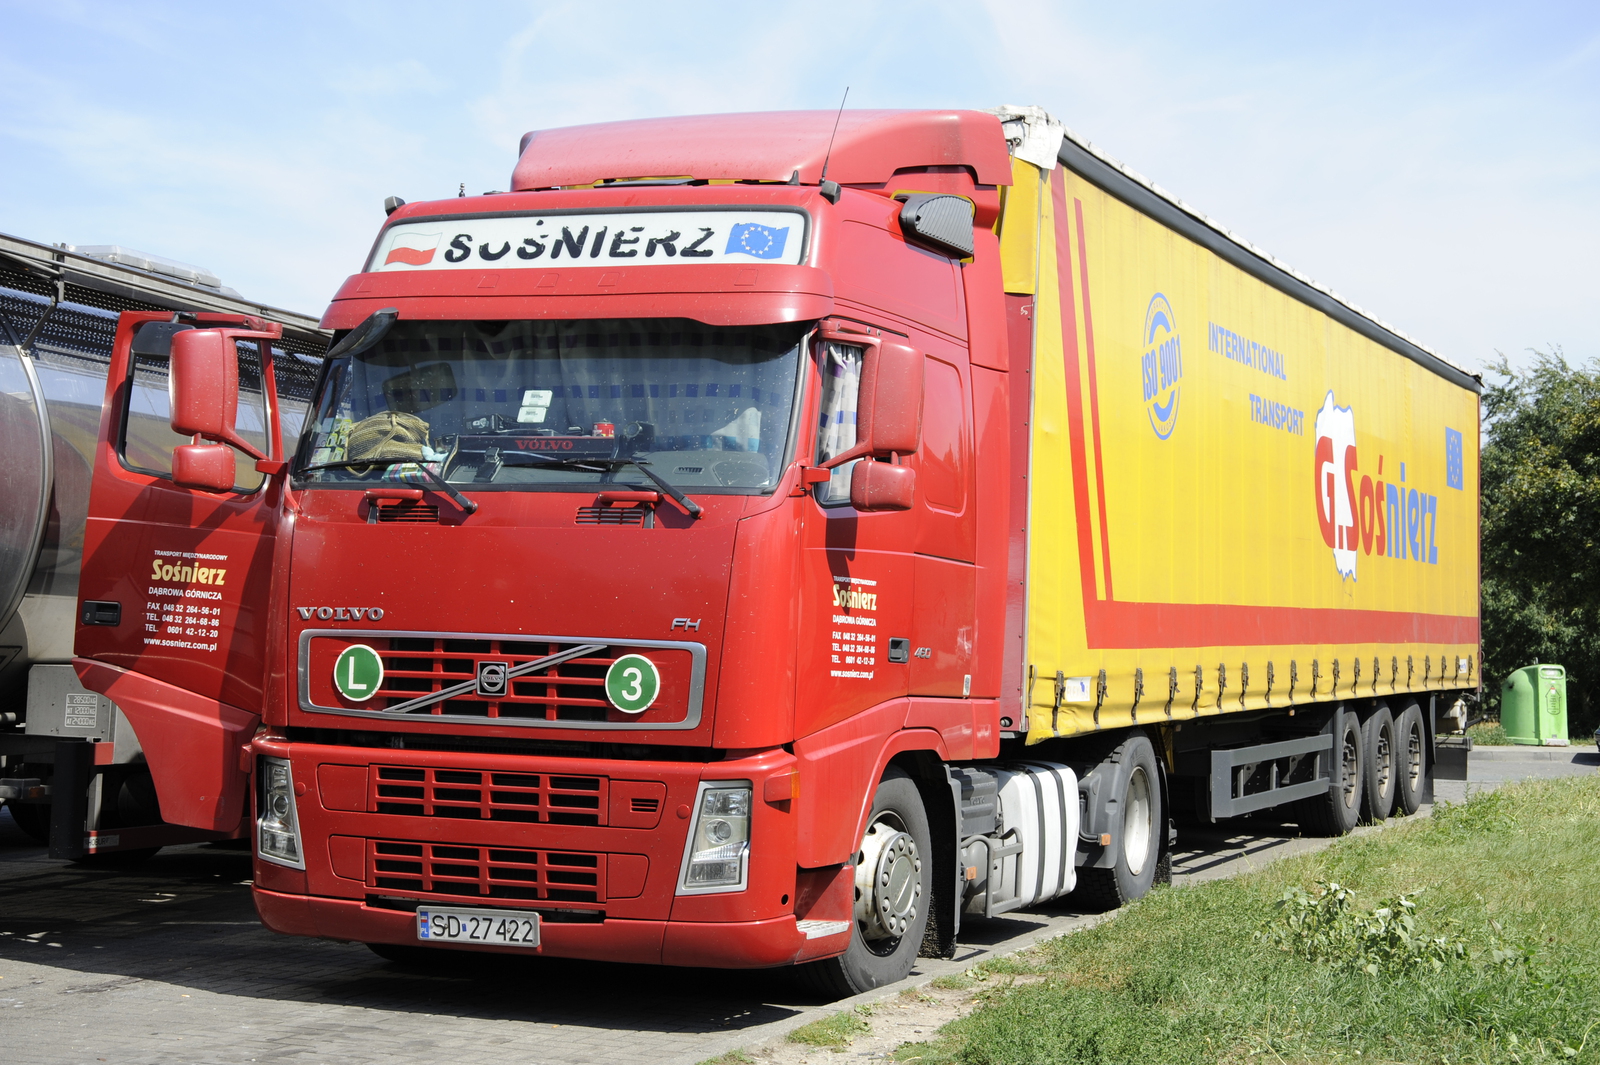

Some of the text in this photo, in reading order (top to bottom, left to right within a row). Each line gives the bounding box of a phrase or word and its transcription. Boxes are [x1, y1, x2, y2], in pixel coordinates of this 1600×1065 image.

[1208, 320, 1287, 381] INTERNATIONAL
[1141, 334, 1183, 402] ISO 9001
[1249, 392, 1304, 437] TRANSPORT
[515, 439, 574, 450] VOLVO
[154, 549, 182, 557] TRANSPORT
[151, 558, 227, 586] Sośnierz
[148, 586, 222, 600] DĄBROWA GÓRNICZA
[832, 583, 877, 611] Sośnierz
[146, 601, 160, 610] FAX
[163, 603, 174, 612] 048
[176, 604, 184, 612] 32
[297, 606, 384, 620] VOLVO
[146, 612, 160, 621] TEL.
[162, 614, 174, 622] 048
[174, 616, 182, 624] 32
[670, 617, 702, 632] FH
[145, 624, 159, 632] TEL.
[167, 626, 182, 634] 0601
[143, 638, 218, 652] www.sosnierz.com.pl
[348, 656, 367, 690] L
[621, 667, 643, 702] 3
[432, 915, 533, 943] SD 27422
